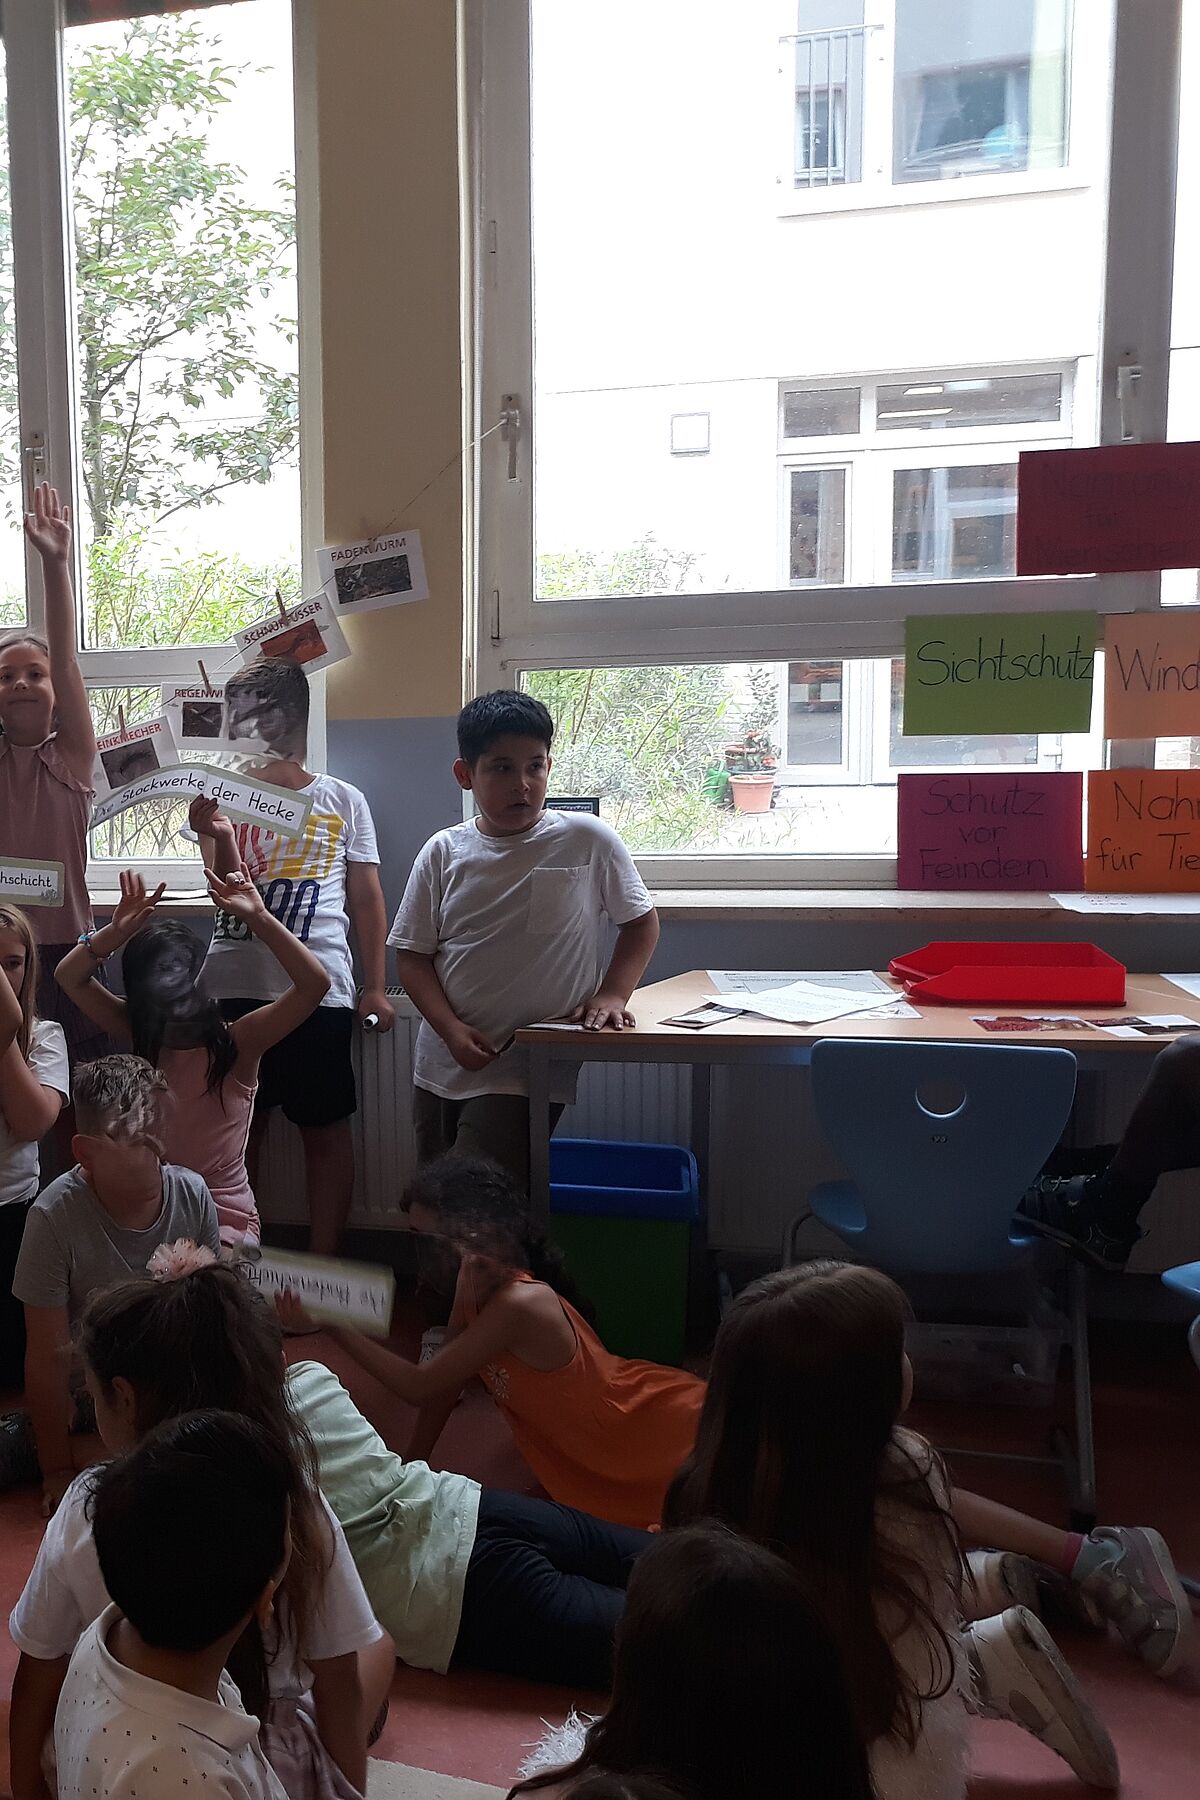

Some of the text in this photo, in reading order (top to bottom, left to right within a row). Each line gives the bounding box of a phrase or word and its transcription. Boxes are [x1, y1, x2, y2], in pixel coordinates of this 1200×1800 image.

[916, 634, 1094, 685] Sichtschutz
[1114, 642, 1200, 691] Wind
[121, 772, 206, 804] Stockwerke
[212, 782, 240, 803] der
[248, 791, 296, 822] Hecke
[920, 779, 1046, 816] Schutz
[958, 826, 1008, 845] vor
[1095, 832, 1200, 872] für Tie
[919, 847, 1049, 881] Feinden
